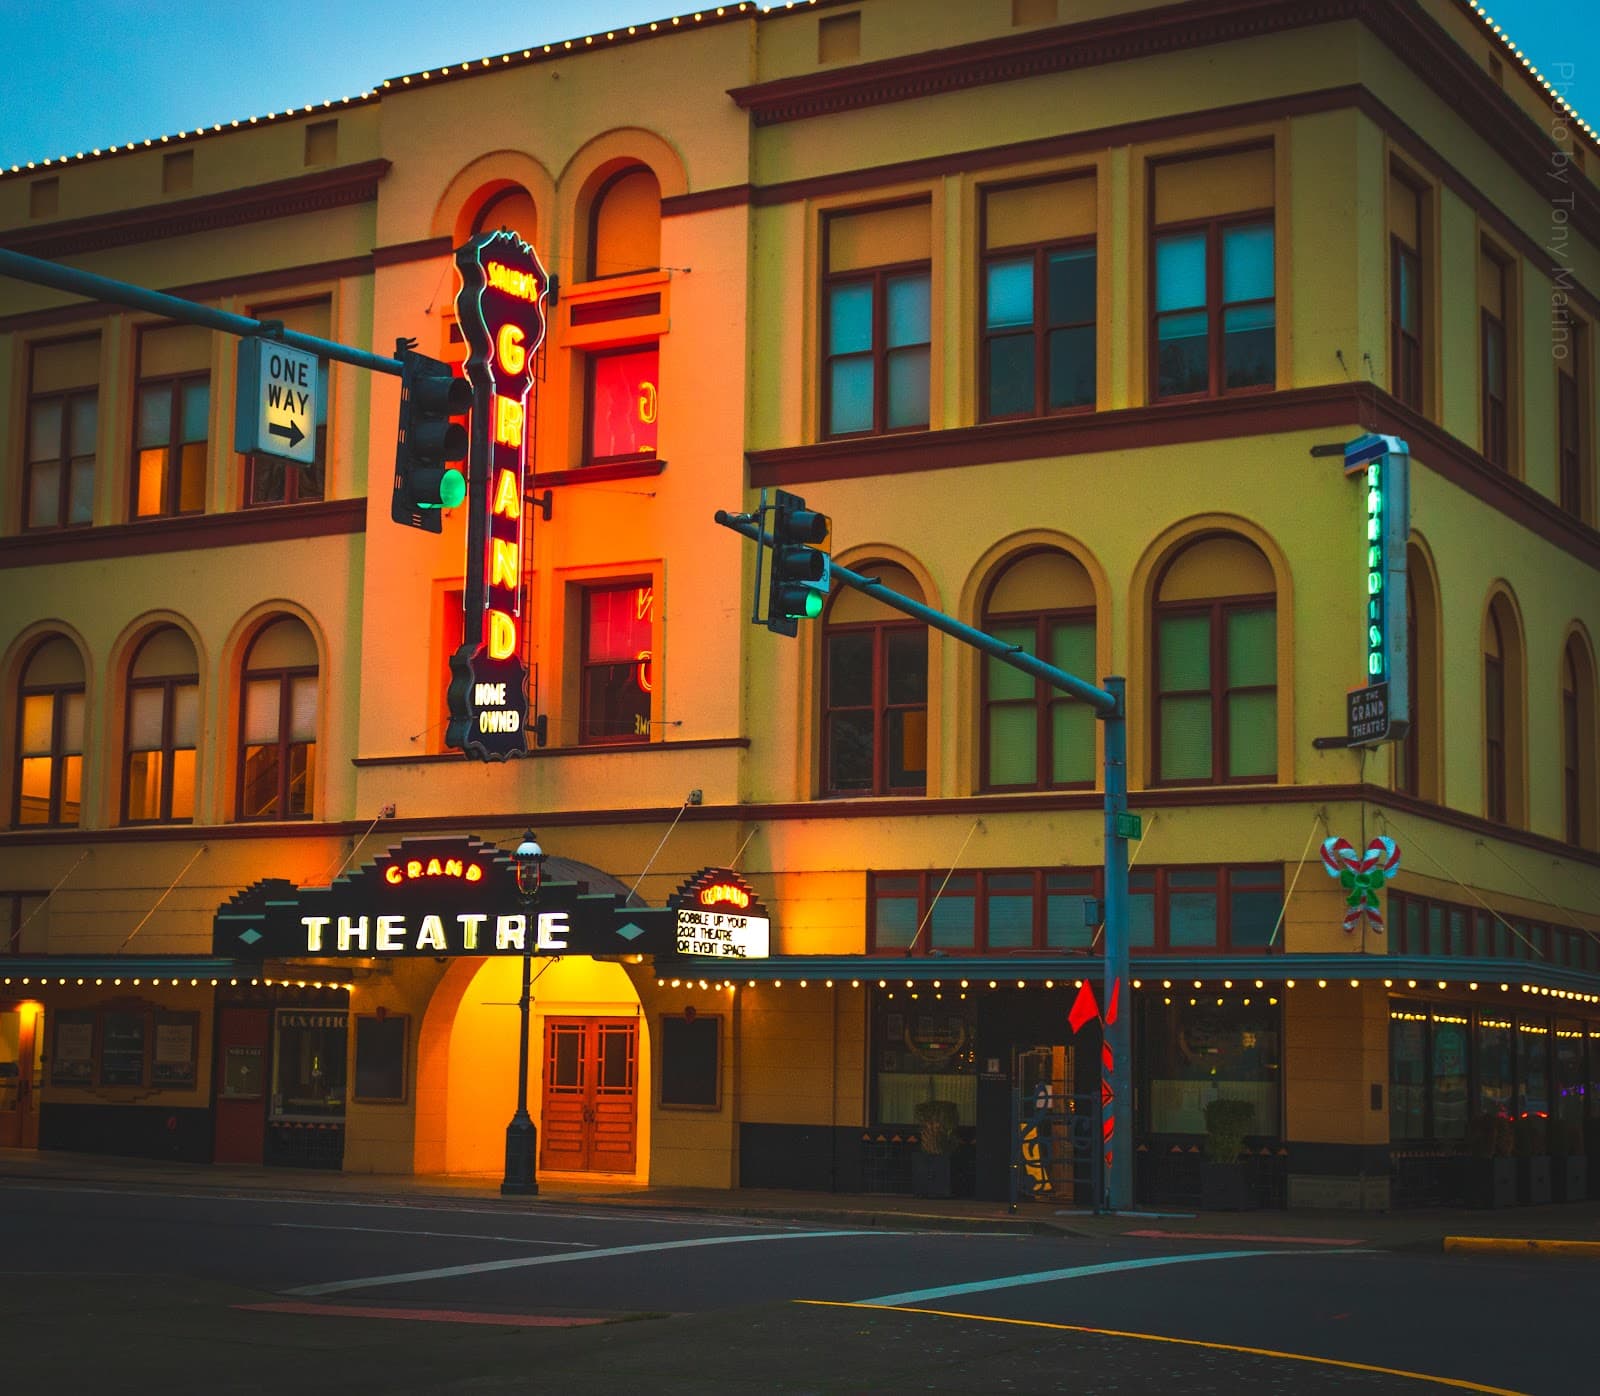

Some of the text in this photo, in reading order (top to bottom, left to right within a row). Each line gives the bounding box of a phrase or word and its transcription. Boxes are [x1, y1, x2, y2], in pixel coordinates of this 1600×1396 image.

[270, 354, 308, 388] ONE
[268, 384, 309, 416] WAY
[489, 323, 525, 660] GRAND
[475, 683, 506, 706] HOME
[479, 710, 520, 733] OWNED
[1352, 700, 1384, 721] GRAND
[1352, 719, 1385, 737] THEATRE
[385, 858, 483, 885] GRAND
[301, 912, 570, 951] THEATRE
[678, 911, 748, 929] GOBBLE UP YOUR
[678, 926, 733, 941] 2021 THEATRE
[678, 940, 747, 957] OR EVENT SPACE
[309, 1016, 347, 1029] OFFIC
